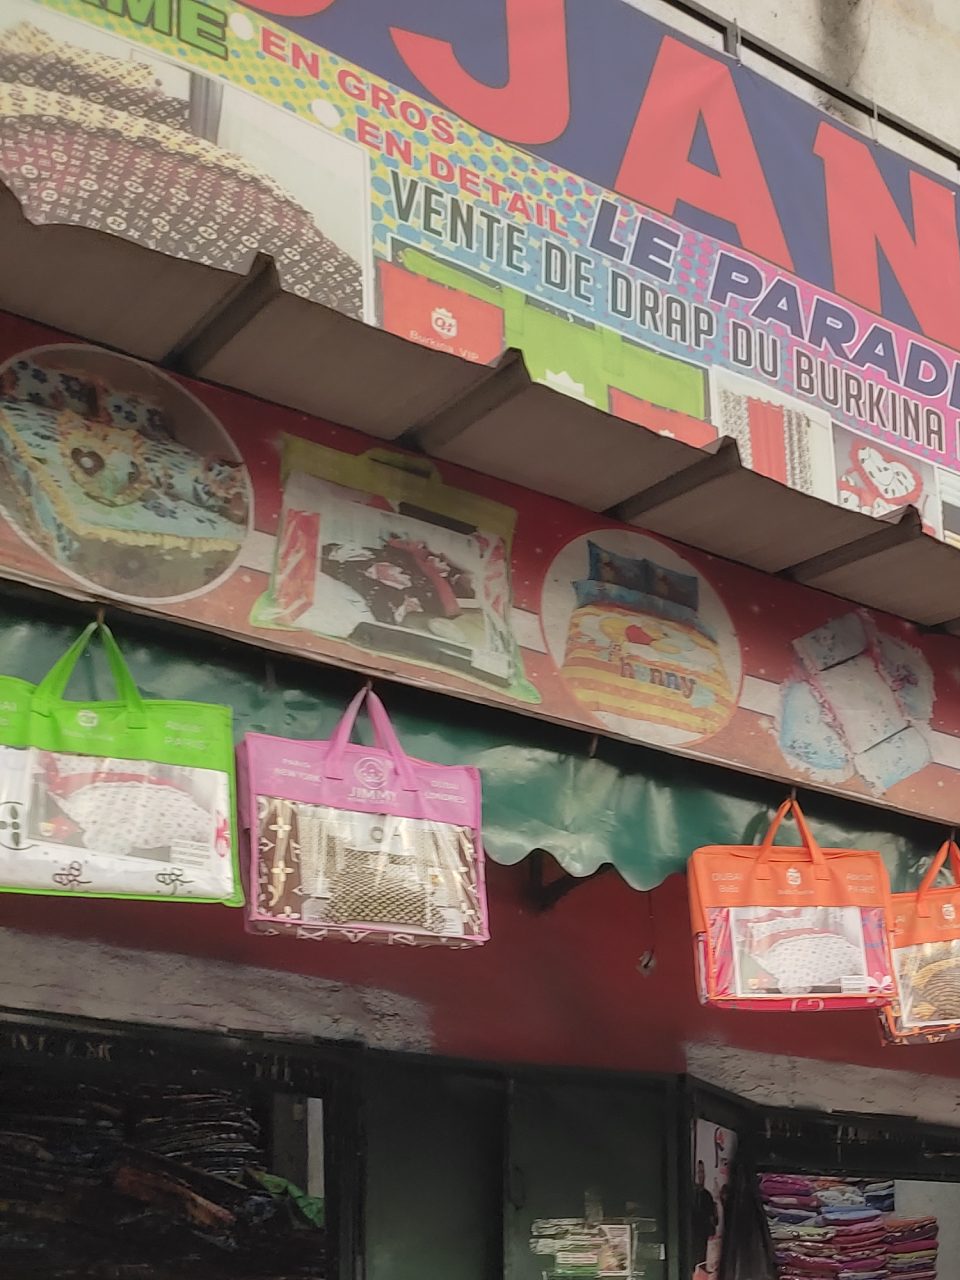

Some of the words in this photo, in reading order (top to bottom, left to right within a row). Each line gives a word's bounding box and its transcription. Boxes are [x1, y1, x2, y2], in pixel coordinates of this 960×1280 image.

[261, 26, 320, 80] EN
[337, 68, 456, 145] GROS
[356, 116, 412, 166] EN
[429, 151, 569, 238] DETAIL
[589, 198, 684, 284] LE
[390, 168, 529, 276] VENTE
[543, 238, 595, 306] DE
[610, 268, 716, 350] DRAP
[731, 318, 781, 380] DU
[793, 346, 946, 454] BURKINA
